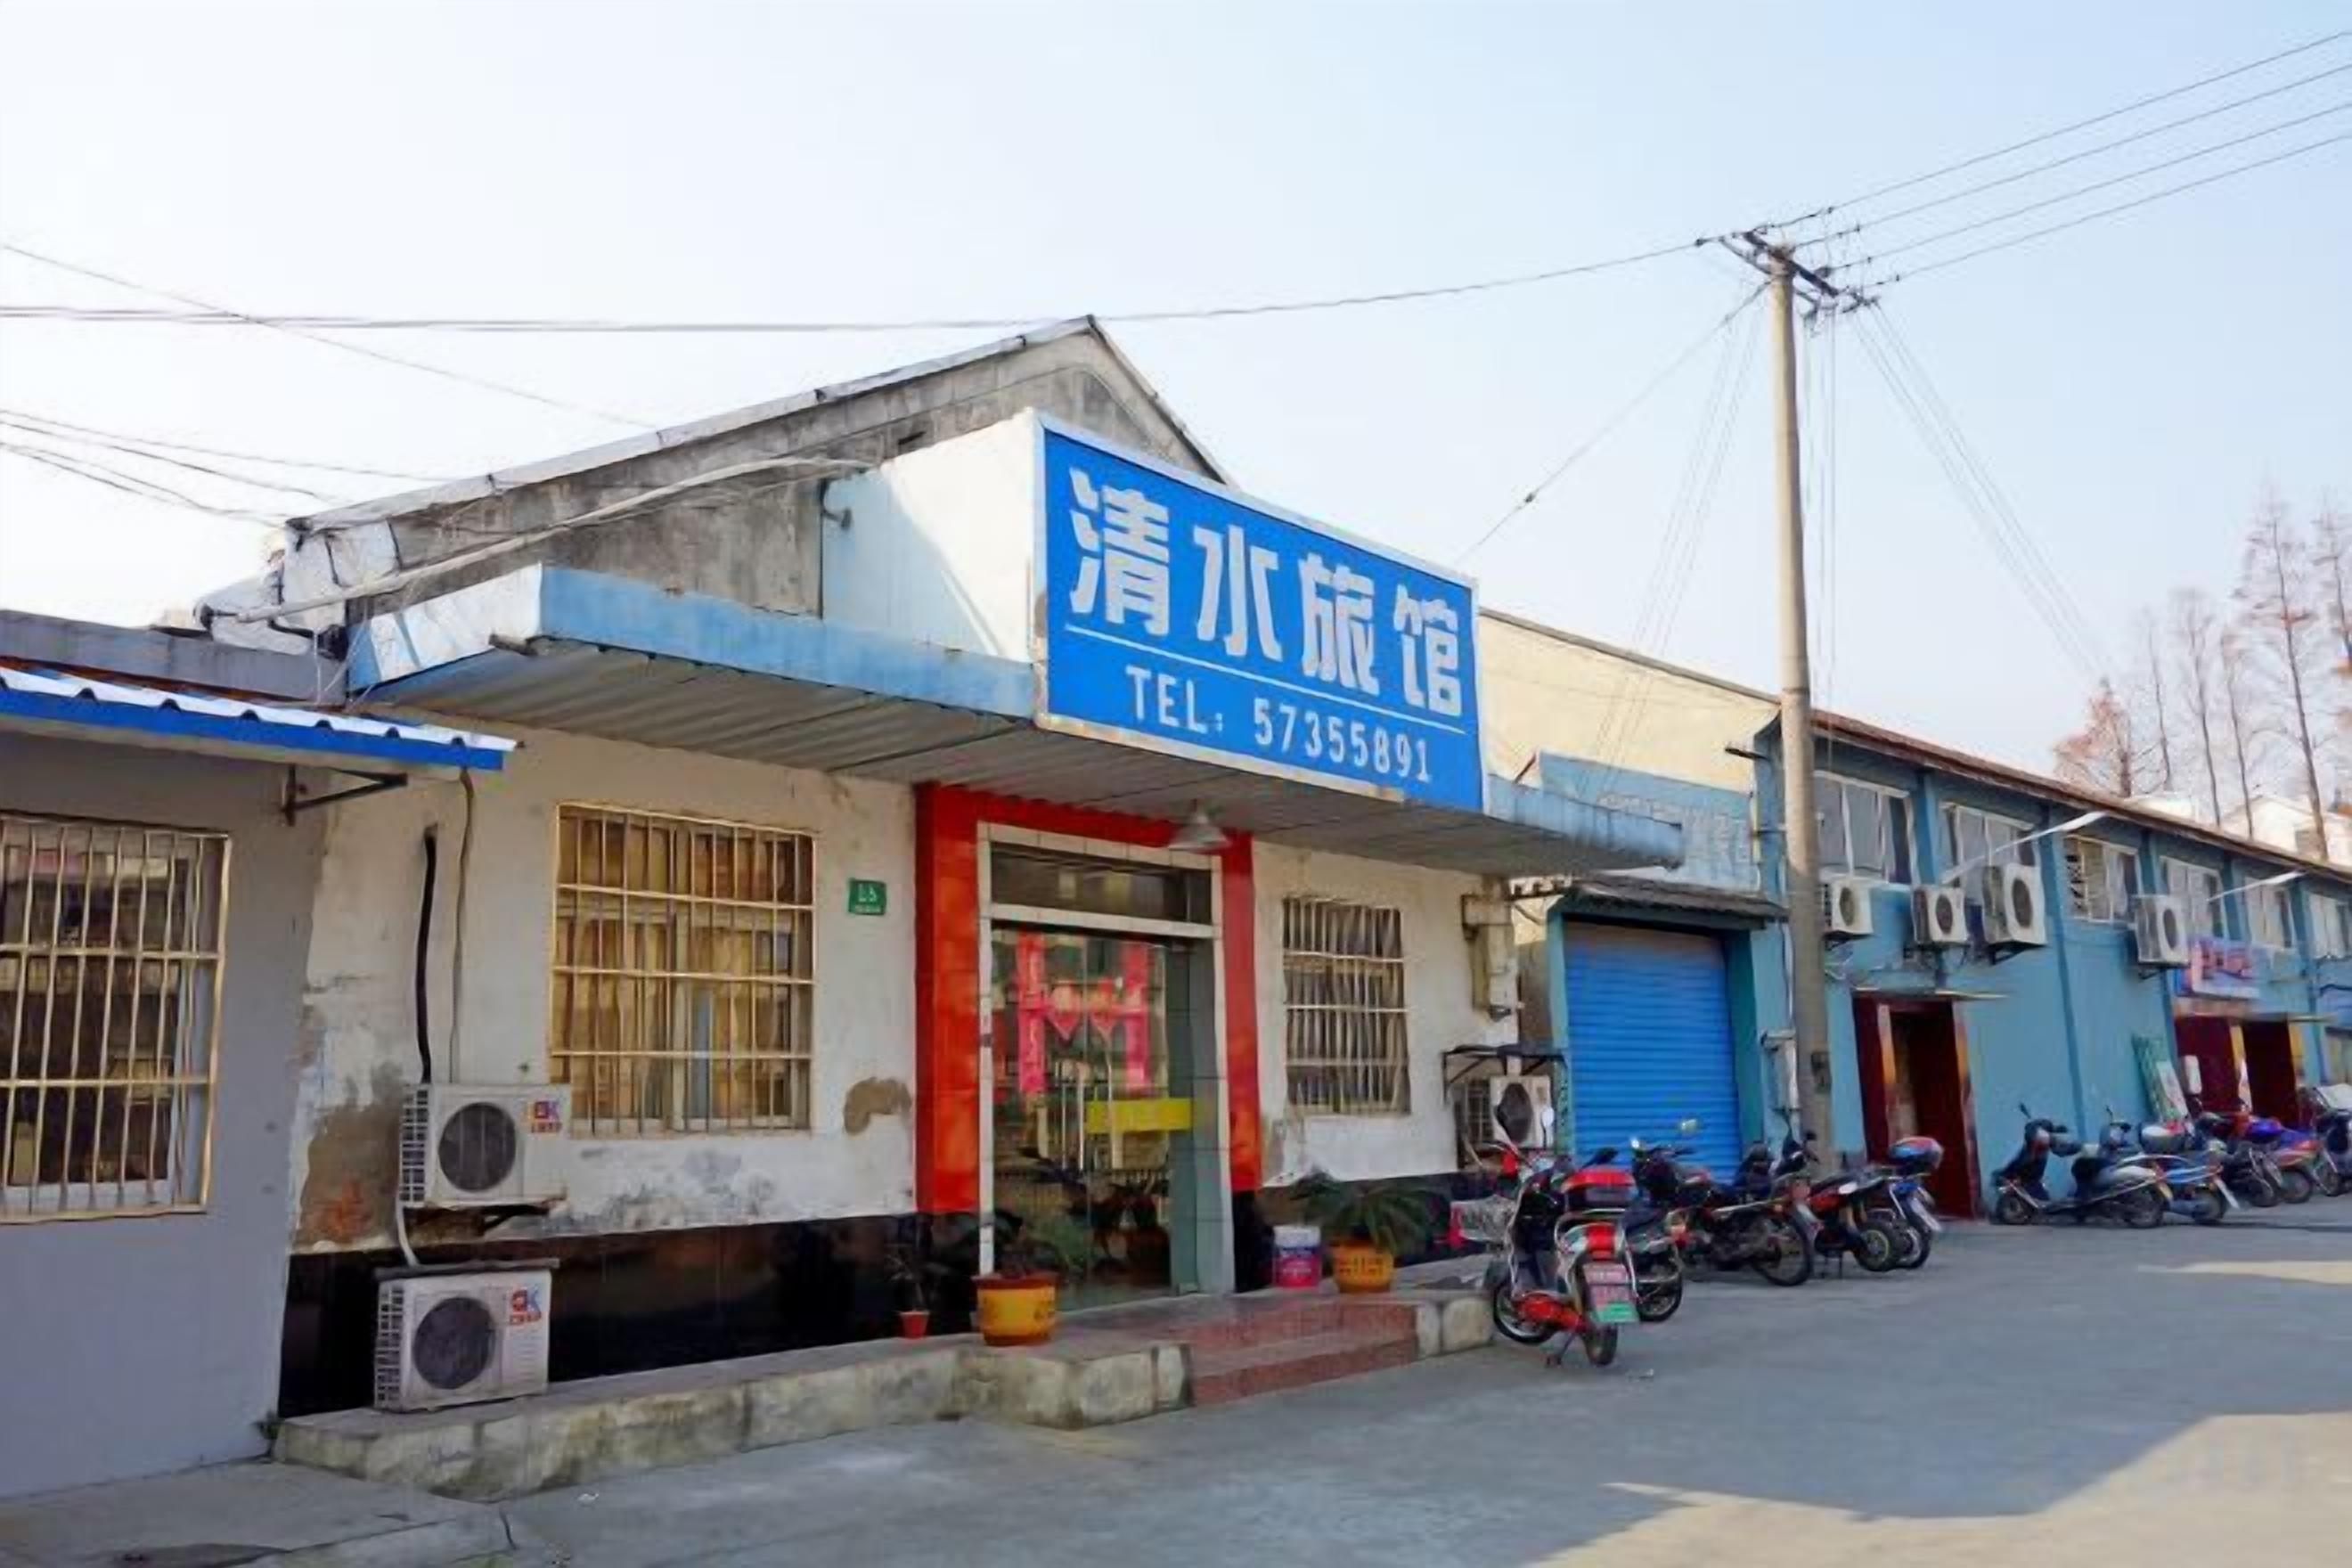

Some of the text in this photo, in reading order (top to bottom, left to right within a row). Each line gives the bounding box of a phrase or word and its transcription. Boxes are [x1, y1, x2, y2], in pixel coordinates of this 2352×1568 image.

[1070, 469, 1462, 716] 清水旅馆
[1254, 698, 1430, 782] 57355891
